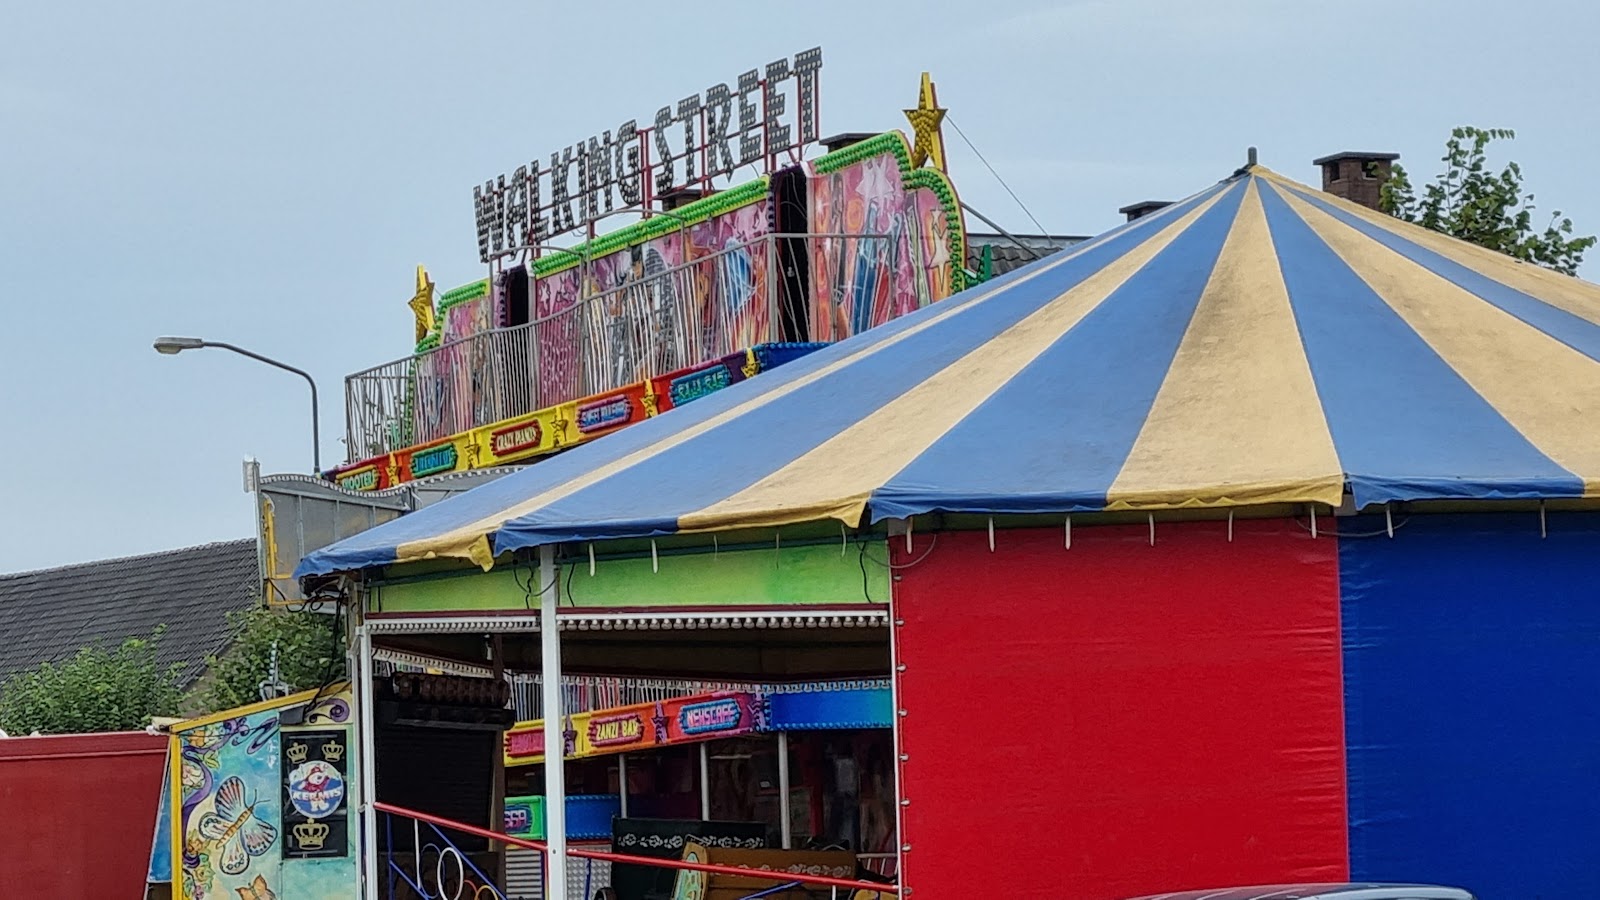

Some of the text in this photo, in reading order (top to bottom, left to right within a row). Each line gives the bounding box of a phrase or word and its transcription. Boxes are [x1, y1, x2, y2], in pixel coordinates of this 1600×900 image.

[473, 46, 823, 264] WALKING STREET
[596, 717, 639, 741] ZANZI BAR
[292, 788, 342, 801] KERMIS
